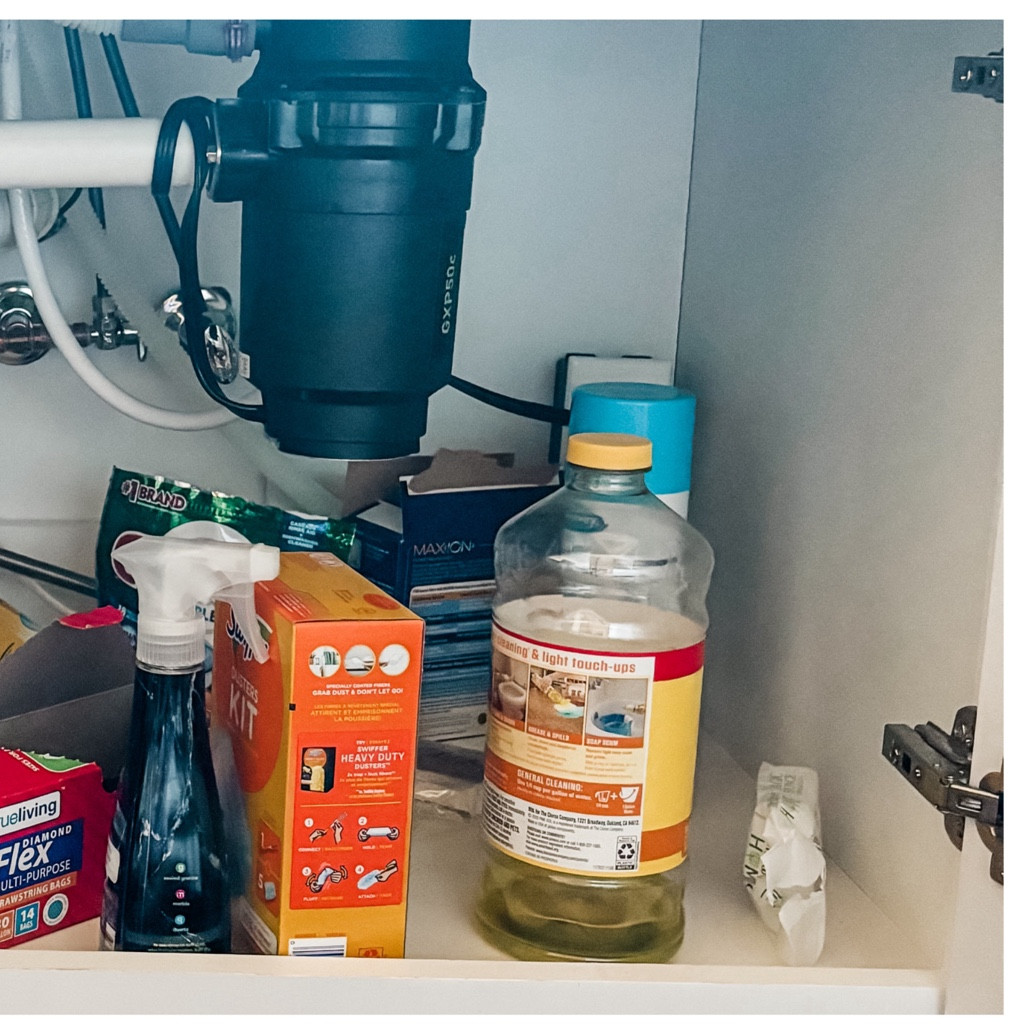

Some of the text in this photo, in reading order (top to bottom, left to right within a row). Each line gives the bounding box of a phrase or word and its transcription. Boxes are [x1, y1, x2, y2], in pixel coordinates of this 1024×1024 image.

[441, 254, 456, 334] GXP50c
[138, 485, 186, 511] BRAND
[531, 649, 539, 660] &
[542, 651, 568, 666] light
[572, 658, 636, 673] touch-ups
[229, 684, 258, 740] KIT
[341, 752, 405, 763] HEAVY DUTY
[517, 769, 584, 792] GENERAL CLEANING:
[22, 825, 72, 848] DIAMOND
[49, 877, 71, 892] BAGS
[20, 908, 35, 919] 14
[19, 920, 34, 931] BAGS
